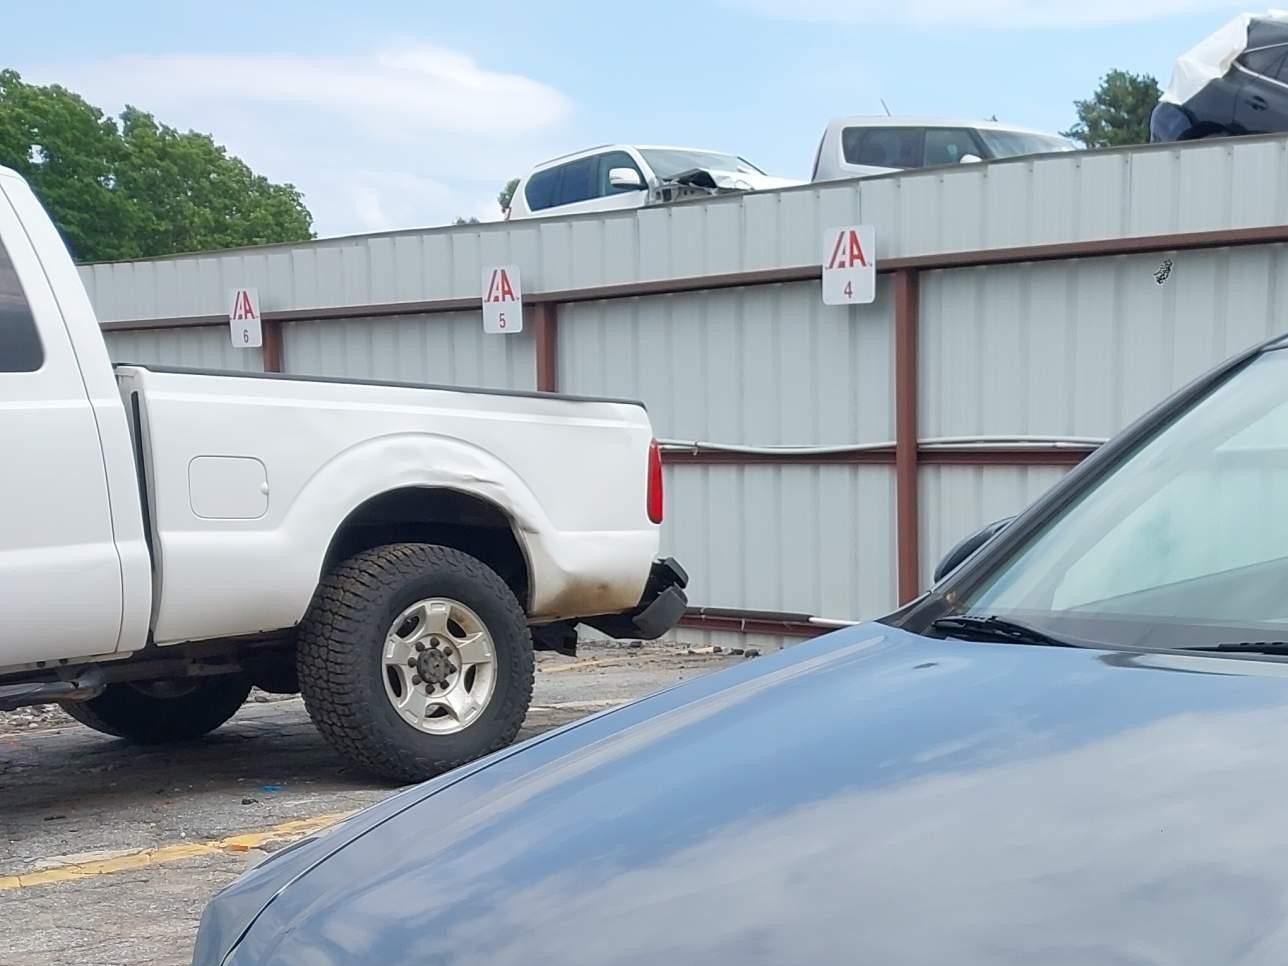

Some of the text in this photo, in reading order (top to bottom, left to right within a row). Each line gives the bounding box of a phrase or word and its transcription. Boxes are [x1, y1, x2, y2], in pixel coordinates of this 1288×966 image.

[844, 280, 853, 299] 4
[499, 312, 506, 329] 5
[243, 329, 249, 344] 6
